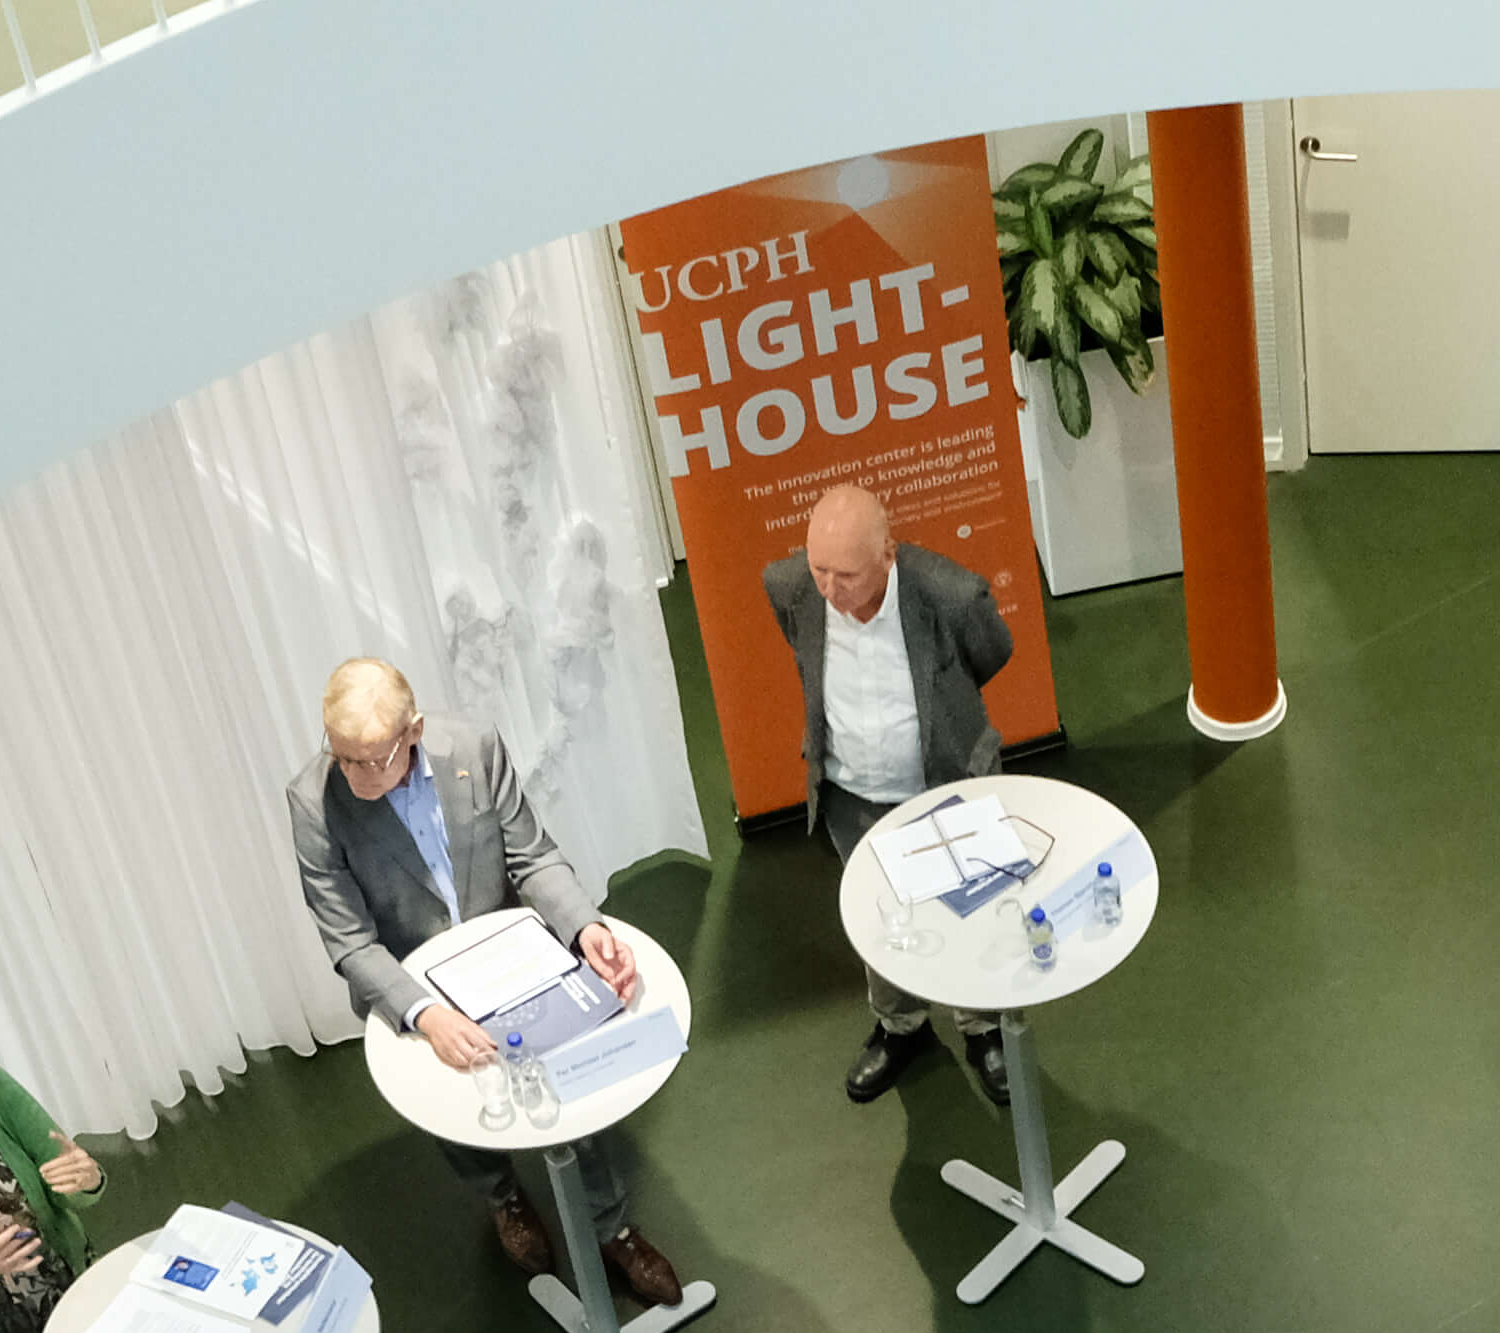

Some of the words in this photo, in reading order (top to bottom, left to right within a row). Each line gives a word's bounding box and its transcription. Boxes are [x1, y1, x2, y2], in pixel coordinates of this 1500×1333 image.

[629, 230, 815, 313] UCPH
[641, 262, 969, 397] LIGHT-
[658, 334, 989, 478] HOUSE
[744, 484, 773, 501] The
[777, 459, 862, 491] innovation
[866, 445, 916, 467] center
[920, 440, 934, 453] is
[936, 425, 994, 449] leading
[792, 490, 819, 506] the
[857, 475, 874, 487] to
[877, 452, 963, 483] knowledge
[967, 440, 996, 460] and
[896, 460, 998, 496] collaboration
